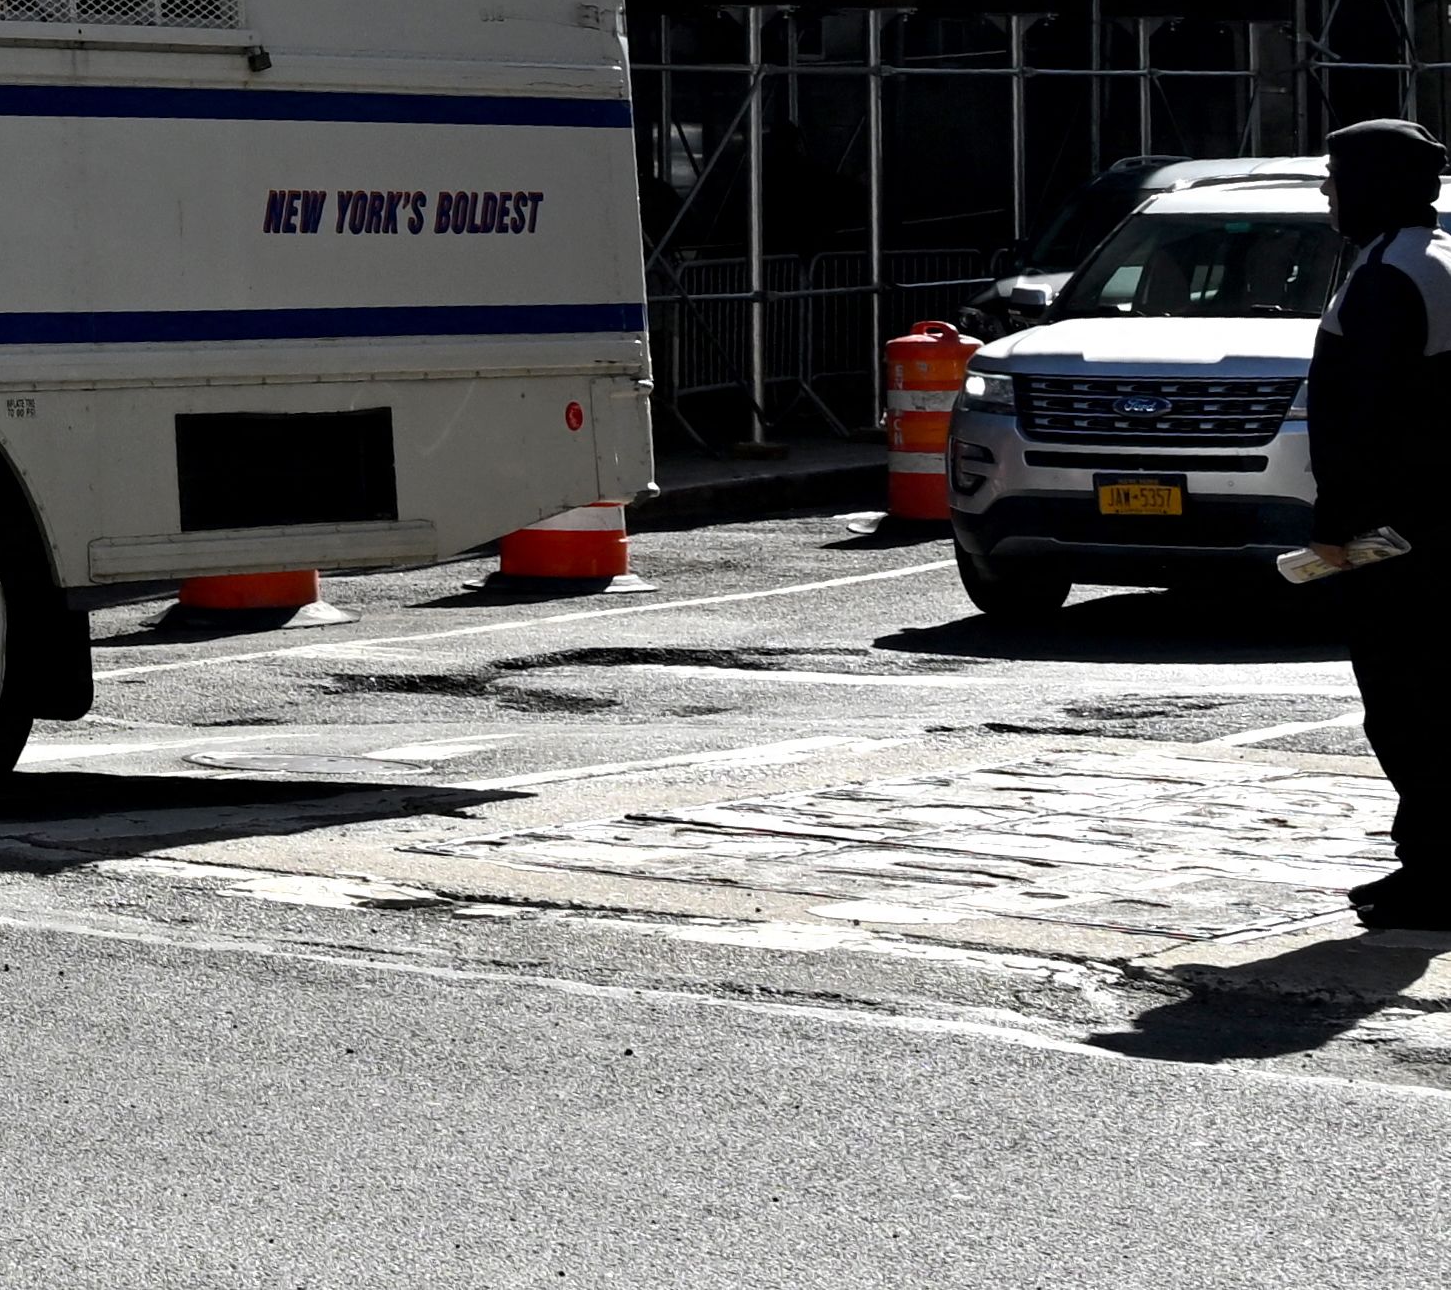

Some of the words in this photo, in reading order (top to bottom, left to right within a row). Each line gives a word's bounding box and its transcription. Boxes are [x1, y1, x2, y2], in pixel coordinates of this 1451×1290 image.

[263, 190, 327, 234] NEW
[335, 190, 427, 235] YORK'S
[433, 191, 545, 235] BOLDEST
[1123, 398, 1158, 412] Ford
